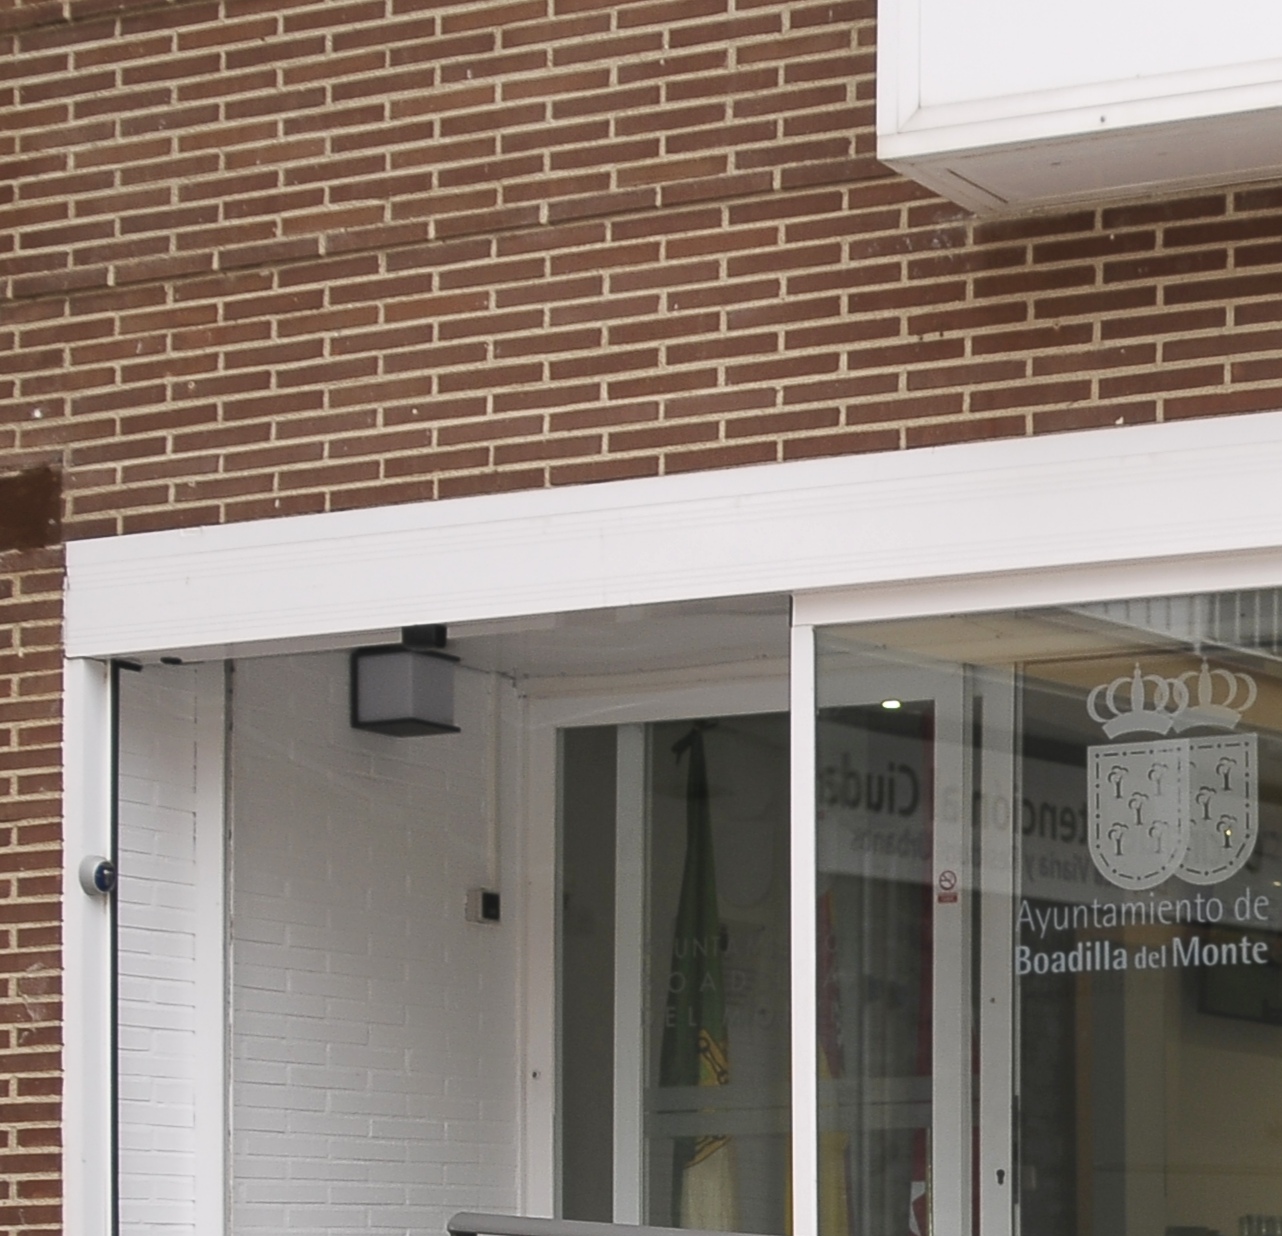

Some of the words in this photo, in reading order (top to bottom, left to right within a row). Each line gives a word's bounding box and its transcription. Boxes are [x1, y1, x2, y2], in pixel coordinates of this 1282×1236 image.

[1015, 893, 1224, 939] Ayuntamiento
[1234, 887, 1270, 922] de
[1014, 939, 1128, 975] Boadilla
[1134, 944, 1168, 970] del
[1172, 936, 1269, 968] Monte
